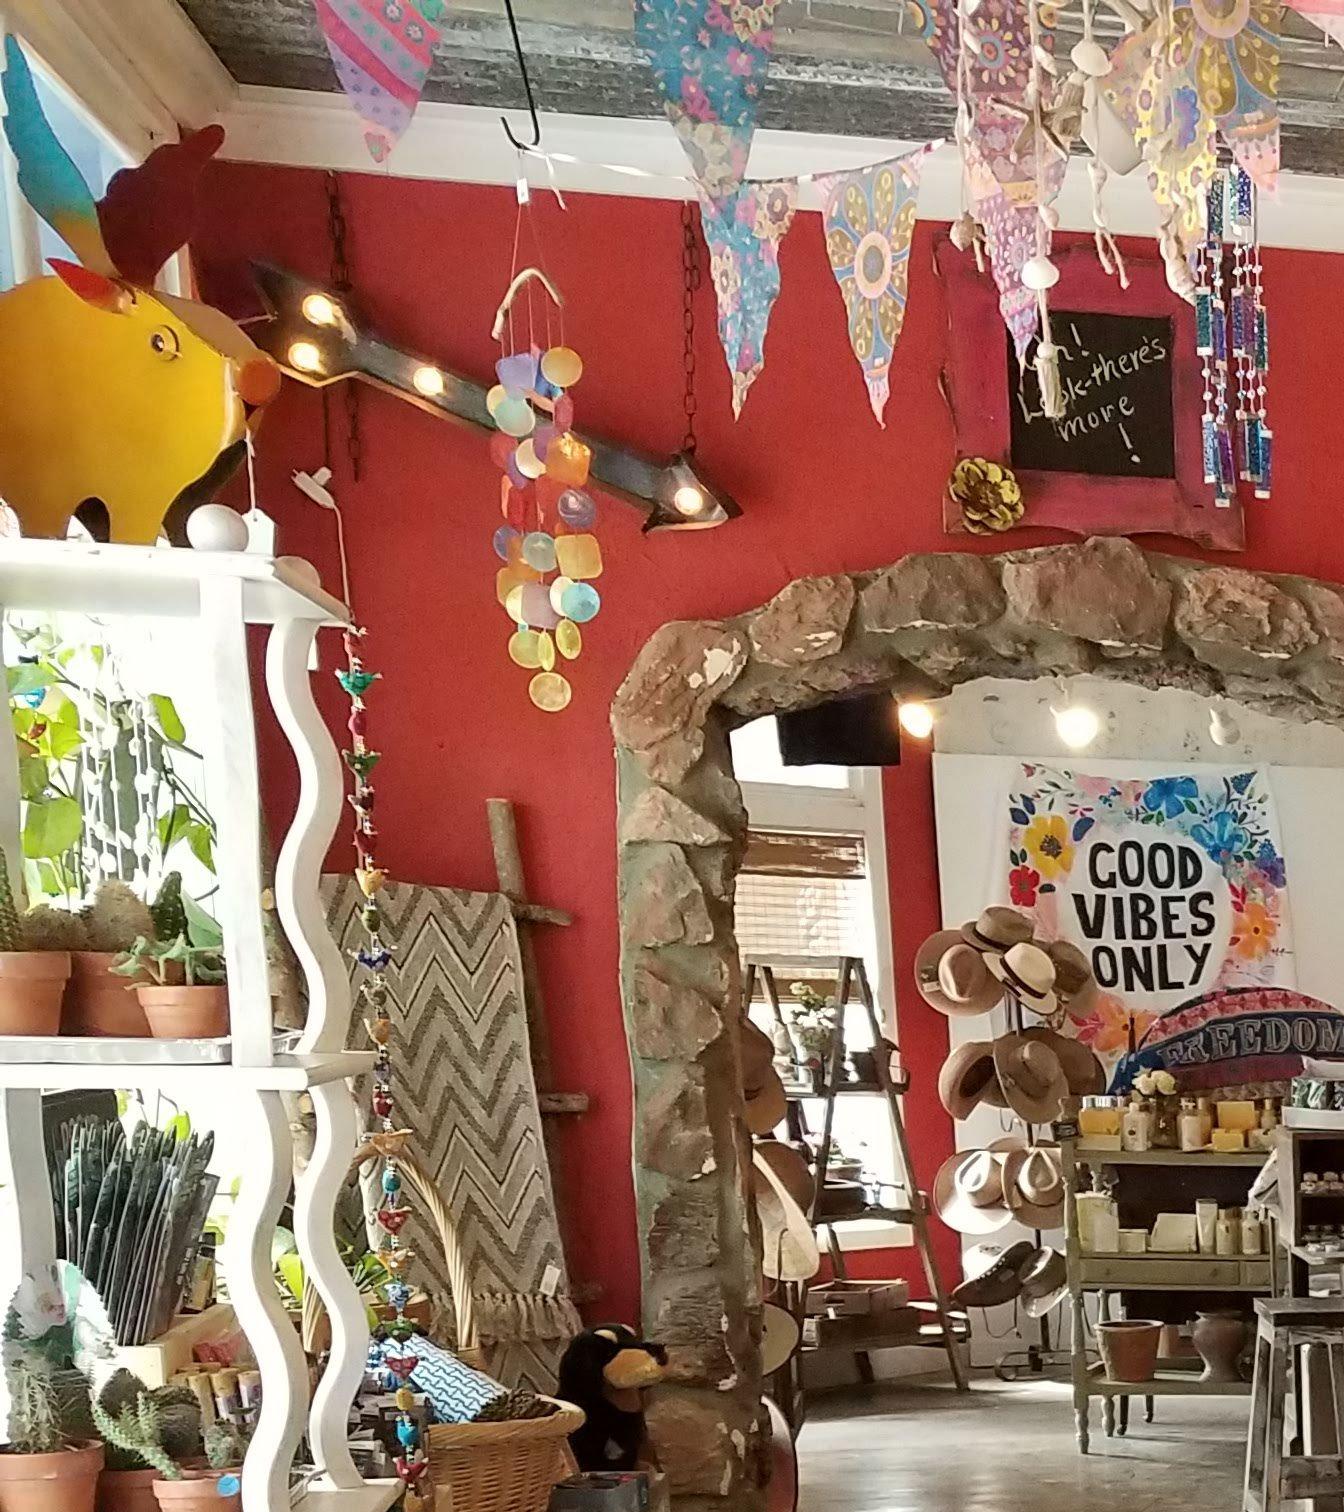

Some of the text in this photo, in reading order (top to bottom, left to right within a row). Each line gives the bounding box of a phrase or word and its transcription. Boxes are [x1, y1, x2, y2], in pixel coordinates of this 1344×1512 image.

[1058, 395, 1135, 442] more
[1088, 840, 1203, 889] GOOD
[1073, 891, 1216, 941] VIBES
[1091, 943, 1213, 993] ONLY
